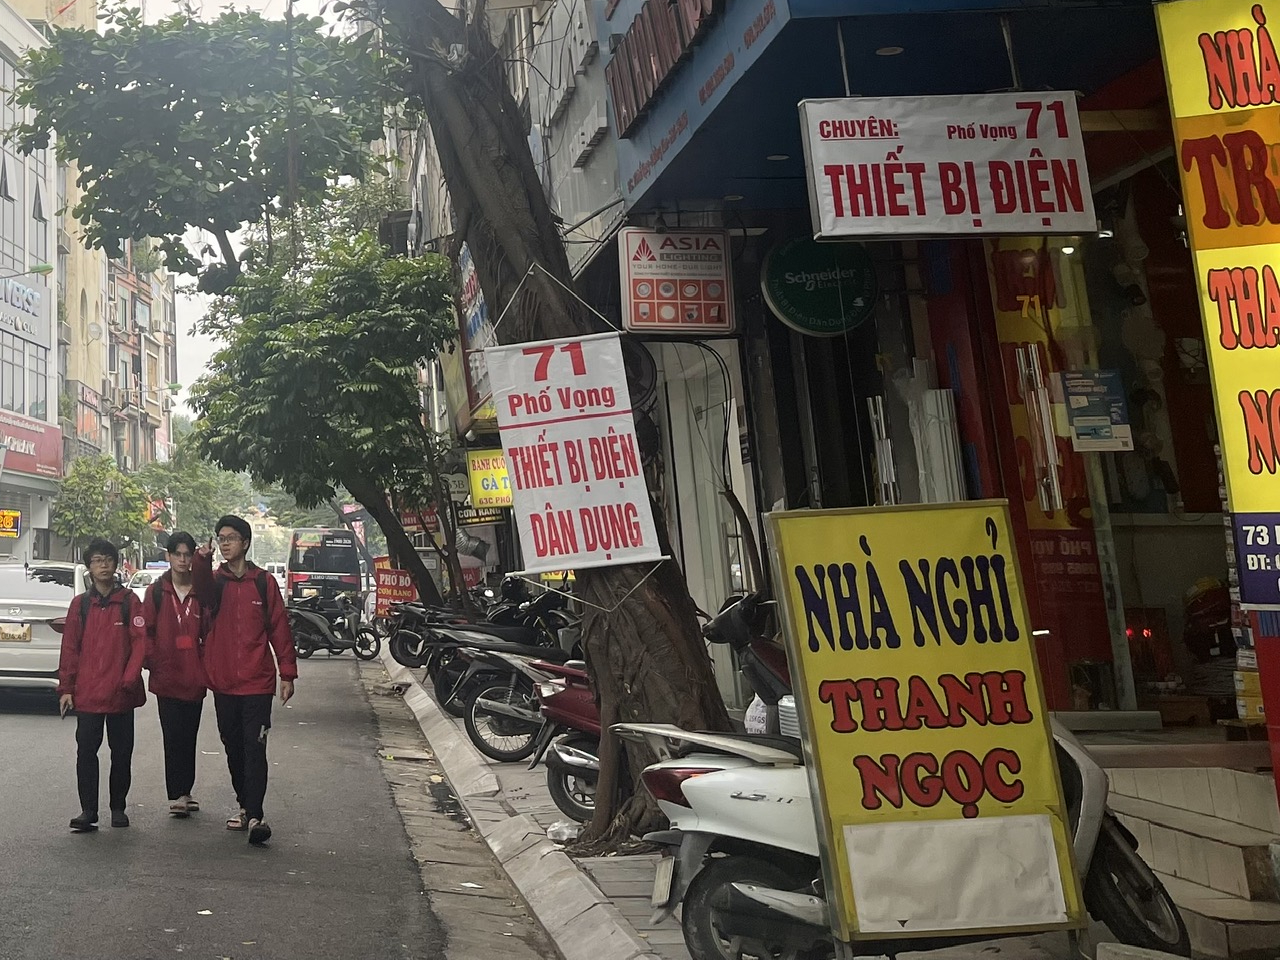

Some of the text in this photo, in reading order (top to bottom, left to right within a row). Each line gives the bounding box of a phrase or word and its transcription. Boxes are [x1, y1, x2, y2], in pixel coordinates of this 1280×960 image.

[820, 116, 899, 139] CHUYÊN:
[947, 100, 1069, 142] Phố Vọng 71
[824, 145, 1084, 228] THIẾT BỊ ĐIỆN
[659, 236, 721, 251] ASIA
[662, 253, 719, 262] LIGHTING
[784, 268, 857, 284] Schneider
[522, 341, 587, 382] 71
[508, 386, 616, 417] Phố Vọng
[472, 456, 506, 471] BÁNH CUỐ
[508, 426, 639, 493] THIẾT BỊ ĐIỆN
[481, 474, 499, 491] GÀ
[458, 508, 476, 519] CƠM
[529, 502, 643, 561] DÂN DỤNG
[1242, 524, 1270, 547] 73
[1246, 552, 1273, 572] ĐT:
[399, 572, 411, 588] BÒ
[794, 517, 1020, 652] NHÀ NGHỈ
[393, 589, 413, 597] RANG
[819, 670, 1034, 734] THANH
[853, 747, 1024, 819] NGỌC
